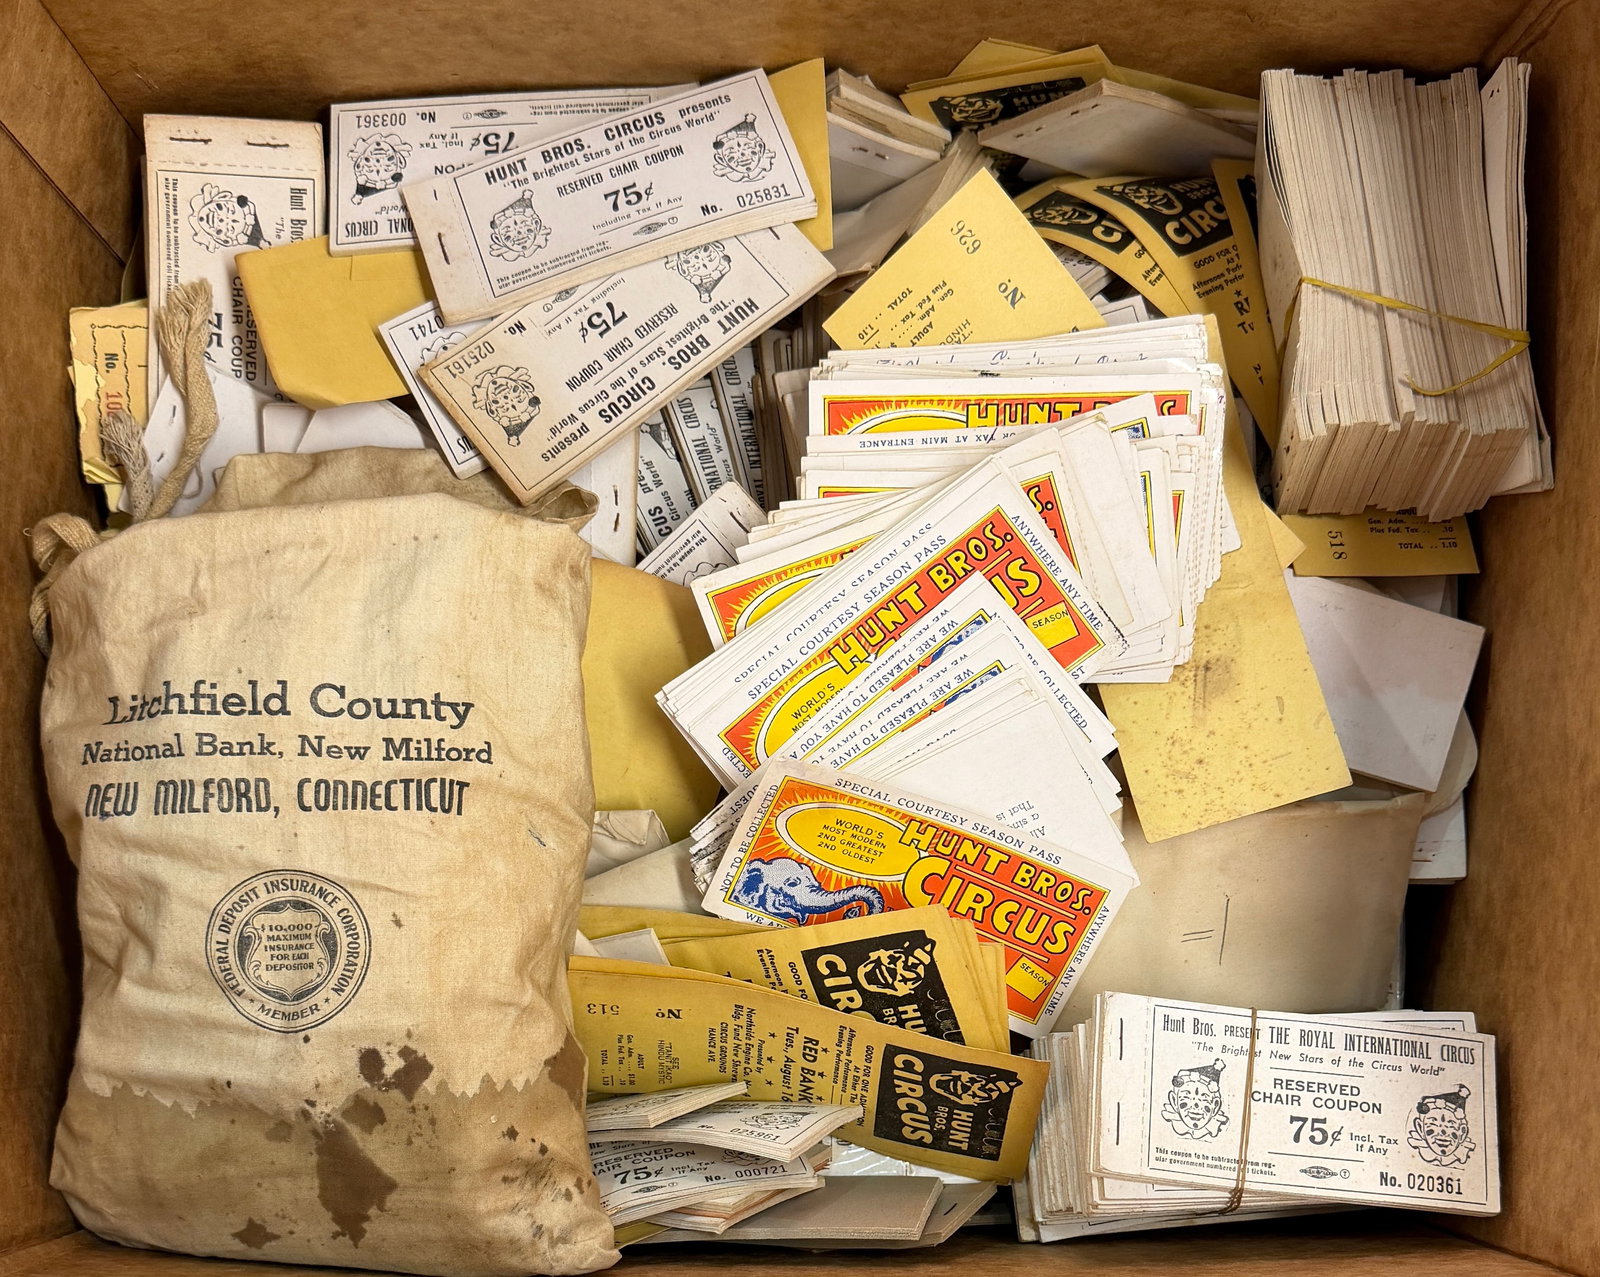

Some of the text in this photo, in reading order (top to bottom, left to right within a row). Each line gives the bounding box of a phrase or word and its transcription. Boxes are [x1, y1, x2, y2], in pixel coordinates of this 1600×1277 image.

[356, 111, 436, 128] No. 003361
[470, 131, 515, 156] 75¢
[485, 95, 731, 185] HUNT BROS. CIRCUS presents
[532, 158, 580, 181] Brightest
[583, 148, 611, 162] Stars
[615, 141, 624, 151] of
[629, 137, 645, 147] the
[649, 125, 682, 140] Circus
[557, 145, 684, 197] RESERVED CHAIR COUPON
[603, 182, 653, 212] 75¢
[700, 184, 790, 216] No. 025831
[290, 188, 307, 243] Hunt Bros.
[1165, 196, 1229, 245] CIRC
[950, 220, 981, 254] 626
[579, 302, 628, 343] 75¢
[858, 288, 913, 340] TOTAL 1.10
[231, 334, 243, 379] COUP
[444, 320, 526, 379] No. 025161
[565, 303, 678, 392] RESERVED CHAIR COUPON
[541, 297, 759, 462] HUNT BROS. CIRCUS presents
[676, 397, 700, 429] CIRCUS
[661, 491, 681, 521] Circus
[1328, 531, 1348, 560] 518
[1012, 515, 1103, 630] ANYWHERE ANY TIME
[829, 521, 1014, 675] HUNT BROS.
[748, 535, 946, 700] SPECIAL COURTESY SEASON PASS
[1032, 609, 1068, 629] SEASON
[800, 620, 958, 753] WE ARE PLEASED TO HAVE YOU
[101, 680, 475, 730] Litchfield County
[80, 732, 493, 766] National Bank, New Milford
[154, 778, 280, 819] MILFORD,
[822, 824, 886, 849] MOST MODERN
[835, 778, 1061, 865] SPECIAL COURTESY SEASON PASS
[836, 818, 884, 839] WORLD'S
[720, 785, 779, 894] NOT TO BE COLLECTED
[817, 832, 883, 857] 2ND GREATEST
[817, 841, 875, 864] 2ND OLDEST
[899, 819, 1092, 915] HUNT BROS.
[903, 856, 1076, 955] CIRCUS
[216, 879, 360, 997] FEDERAL DEPOSIT INSURANCE CORPORATION
[264, 942, 315, 952] INSURANCE
[267, 933, 312, 942] MAXIMUM
[1020, 963, 1049, 986] SEASON
[1044, 903, 1109, 1016] ANYWHERE ANY TIME
[258, 1003, 320, 1021] MEMBER
[587, 1003, 619, 1015] 513
[1163, 1014, 1185, 1033] Hunt
[1193, 1017, 1216, 1037] Bros.
[1269, 1026, 1290, 1045] THE
[1299, 1029, 1335, 1049] ROYAL
[1344, 1033, 1432, 1060] INTERNATIONAL
[1440, 1044, 1475, 1065] CIRCUS
[781, 1055, 796, 1089] August
[798, 1036, 819, 1103] RED BANK
[1221, 1044, 1262, 1060] Brightst
[1269, 1050, 1291, 1060] New
[1299, 1053, 1323, 1064] Stars
[1331, 1056, 1341, 1067] of
[1348, 1057, 1364, 1068] the
[1371, 1060, 1402, 1072] Circus
[779, 1092, 794, 1103] 16
[894, 1053, 933, 1145] CIRCUS
[1250, 1089, 1382, 1114] CHAIR COUPON
[1274, 1078, 1360, 1097] RESERVED
[934, 1106, 949, 1131] BROS.
[948, 1109, 974, 1150] HUNT
[1289, 1115, 1344, 1147] 75¢
[614, 1166, 664, 1184] 75¢
[735, 1164, 787, 1178] 000721
[1380, 1172, 1463, 1195] No. 020361
